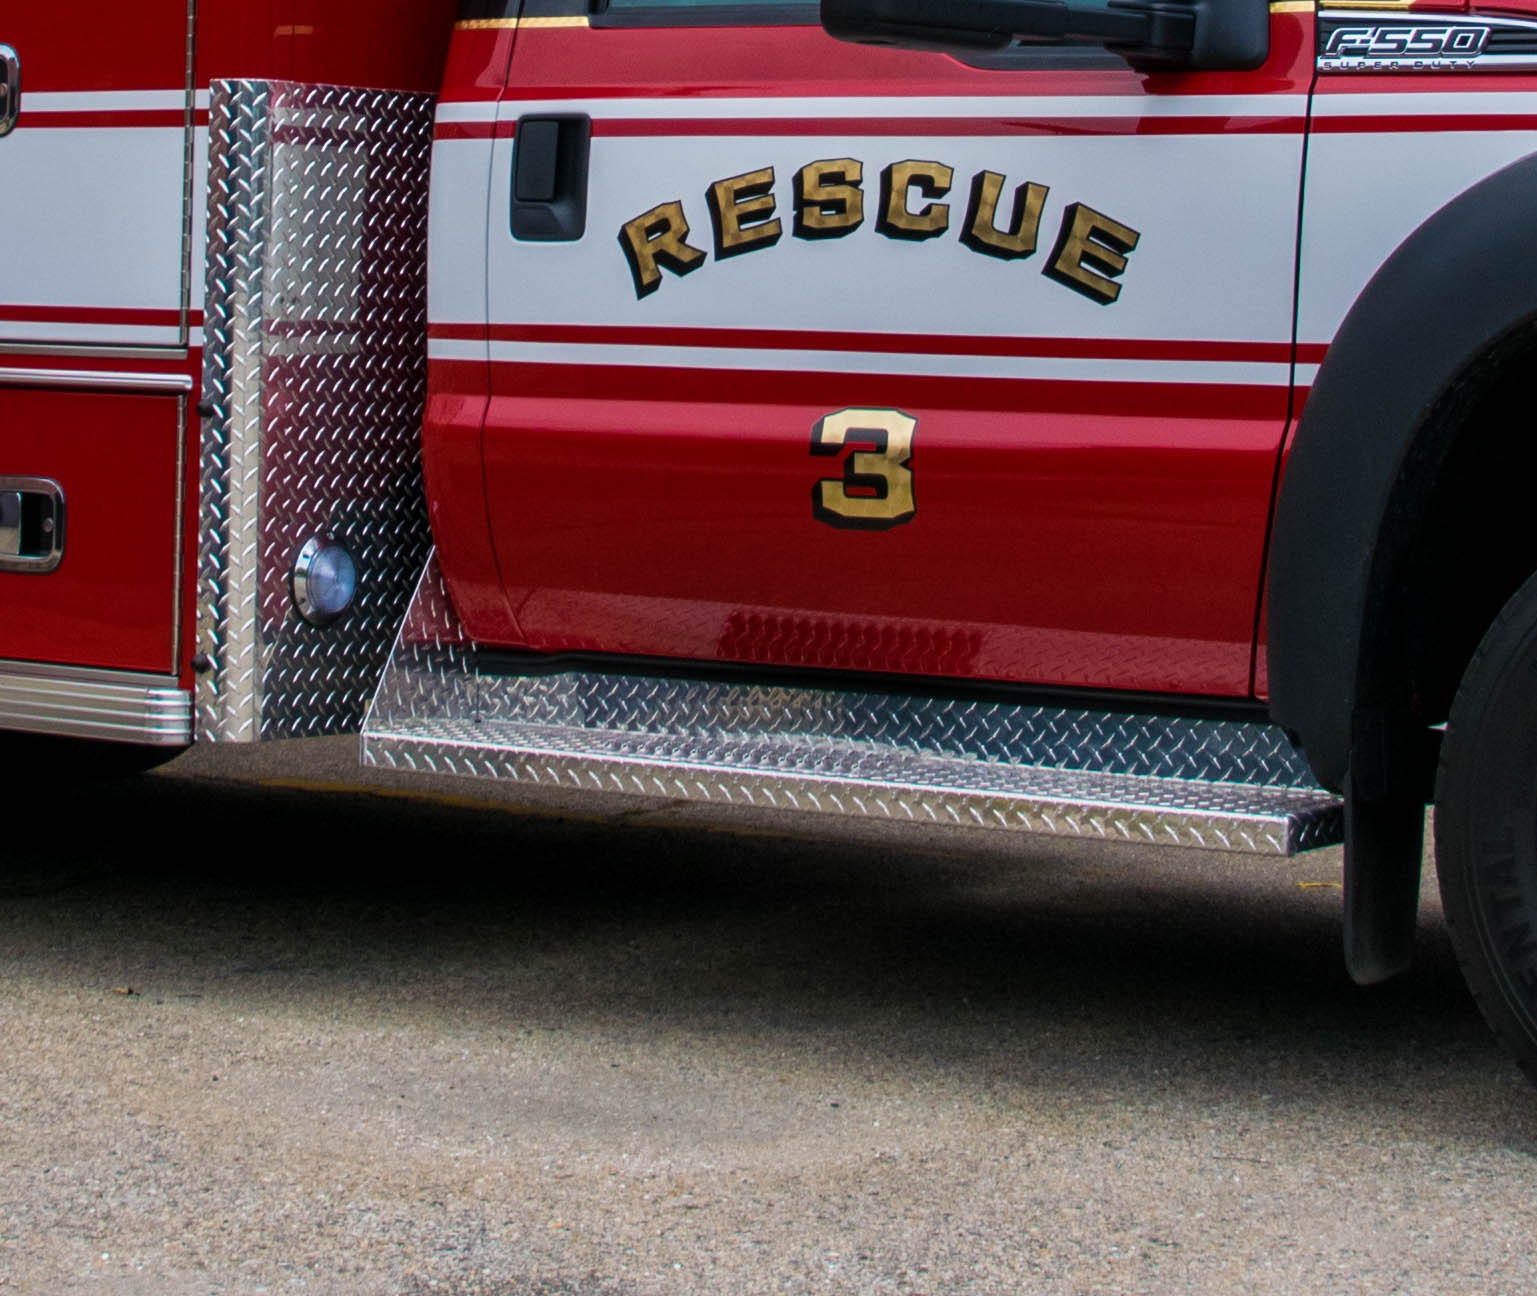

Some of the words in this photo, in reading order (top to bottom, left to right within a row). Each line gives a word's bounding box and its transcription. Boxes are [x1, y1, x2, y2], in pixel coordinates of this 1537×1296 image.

[1319, 26, 1492, 58] F-550
[1322, 60, 1401, 71] SUPER
[1413, 59, 1476, 70] DUTY
[617, 157, 1141, 306] RESCUE
[811, 408, 917, 531] 3
